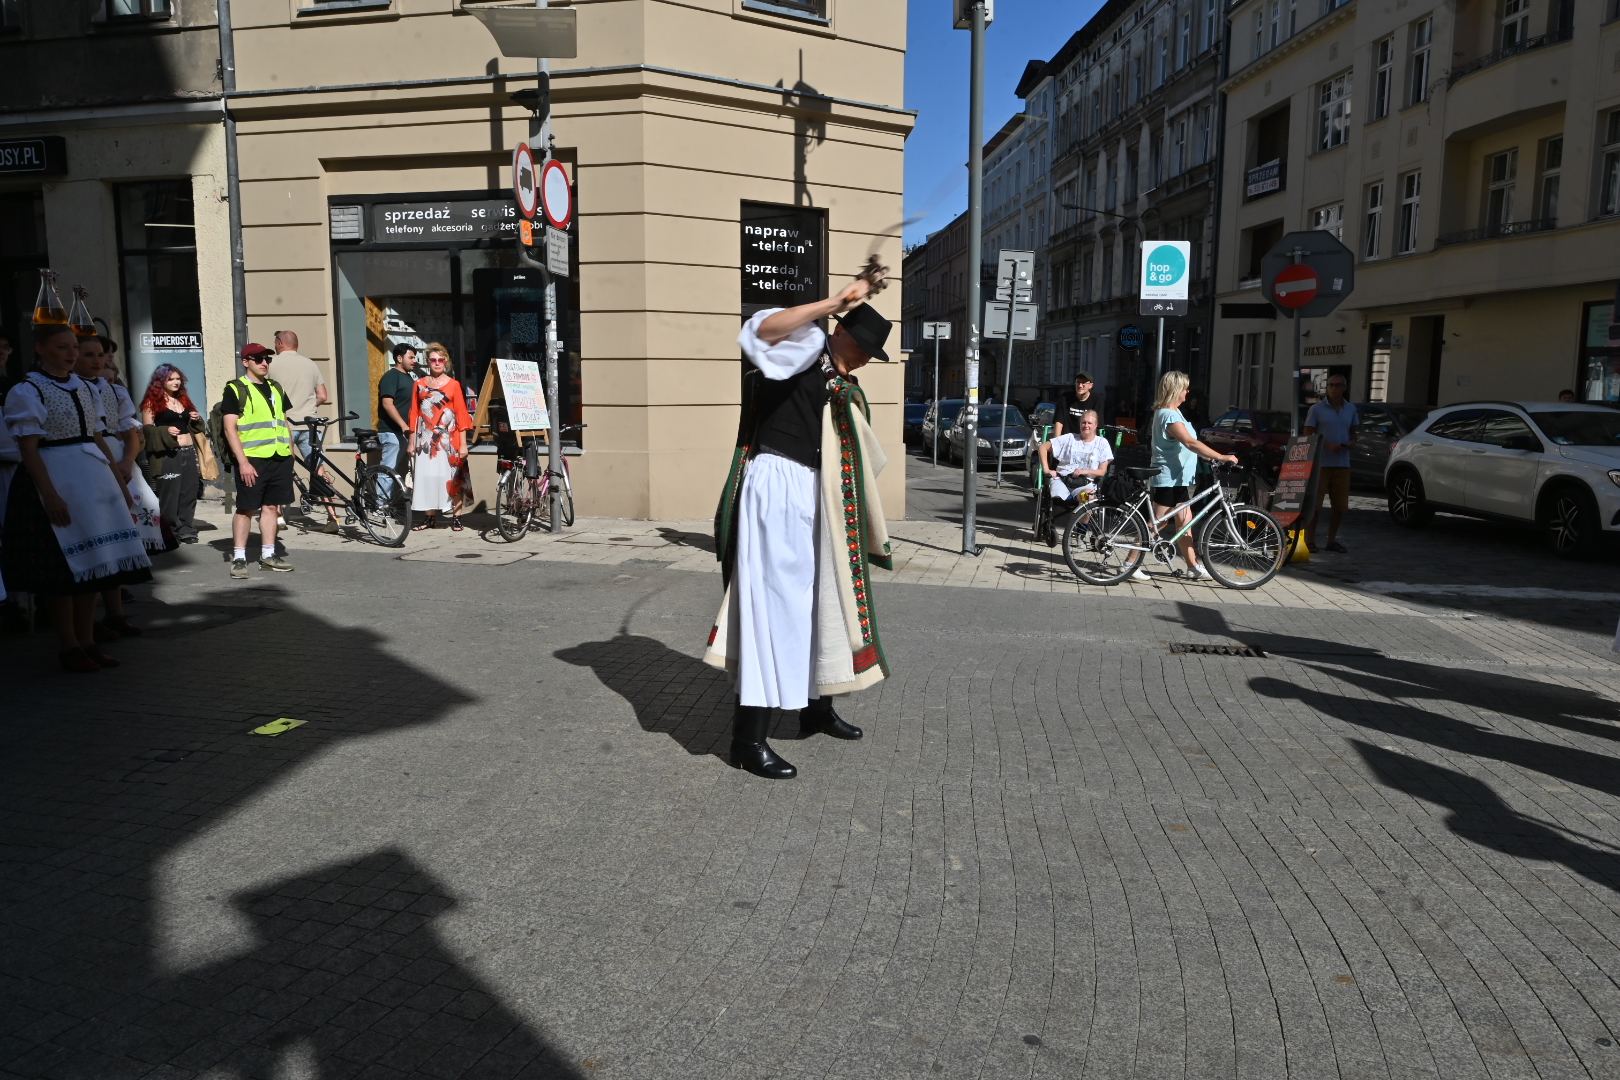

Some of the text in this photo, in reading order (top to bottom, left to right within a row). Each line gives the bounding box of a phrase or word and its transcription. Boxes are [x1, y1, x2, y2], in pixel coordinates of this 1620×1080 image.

[1248, 166, 1279, 184] SPRZEDAM
[385, 205, 515, 223] sprzedaż serwis
[386, 223, 424, 235] telefony
[431, 221, 473, 233] akcesoria
[481, 220, 521, 233] gadżety
[745, 225, 799, 239] napraw
[752, 240, 805, 254] -telefon
[745, 264, 799, 278] sprzedaj
[1150, 262, 1170, 274] hop
[1150, 271, 1172, 284] & go
[752, 279, 804, 291] -telefon
[143, 335, 199, 346] E-PAPIEROSY.PL
[1303, 344, 1346, 356] PIEKARNIA
[1289, 443, 1310, 461] GSM
